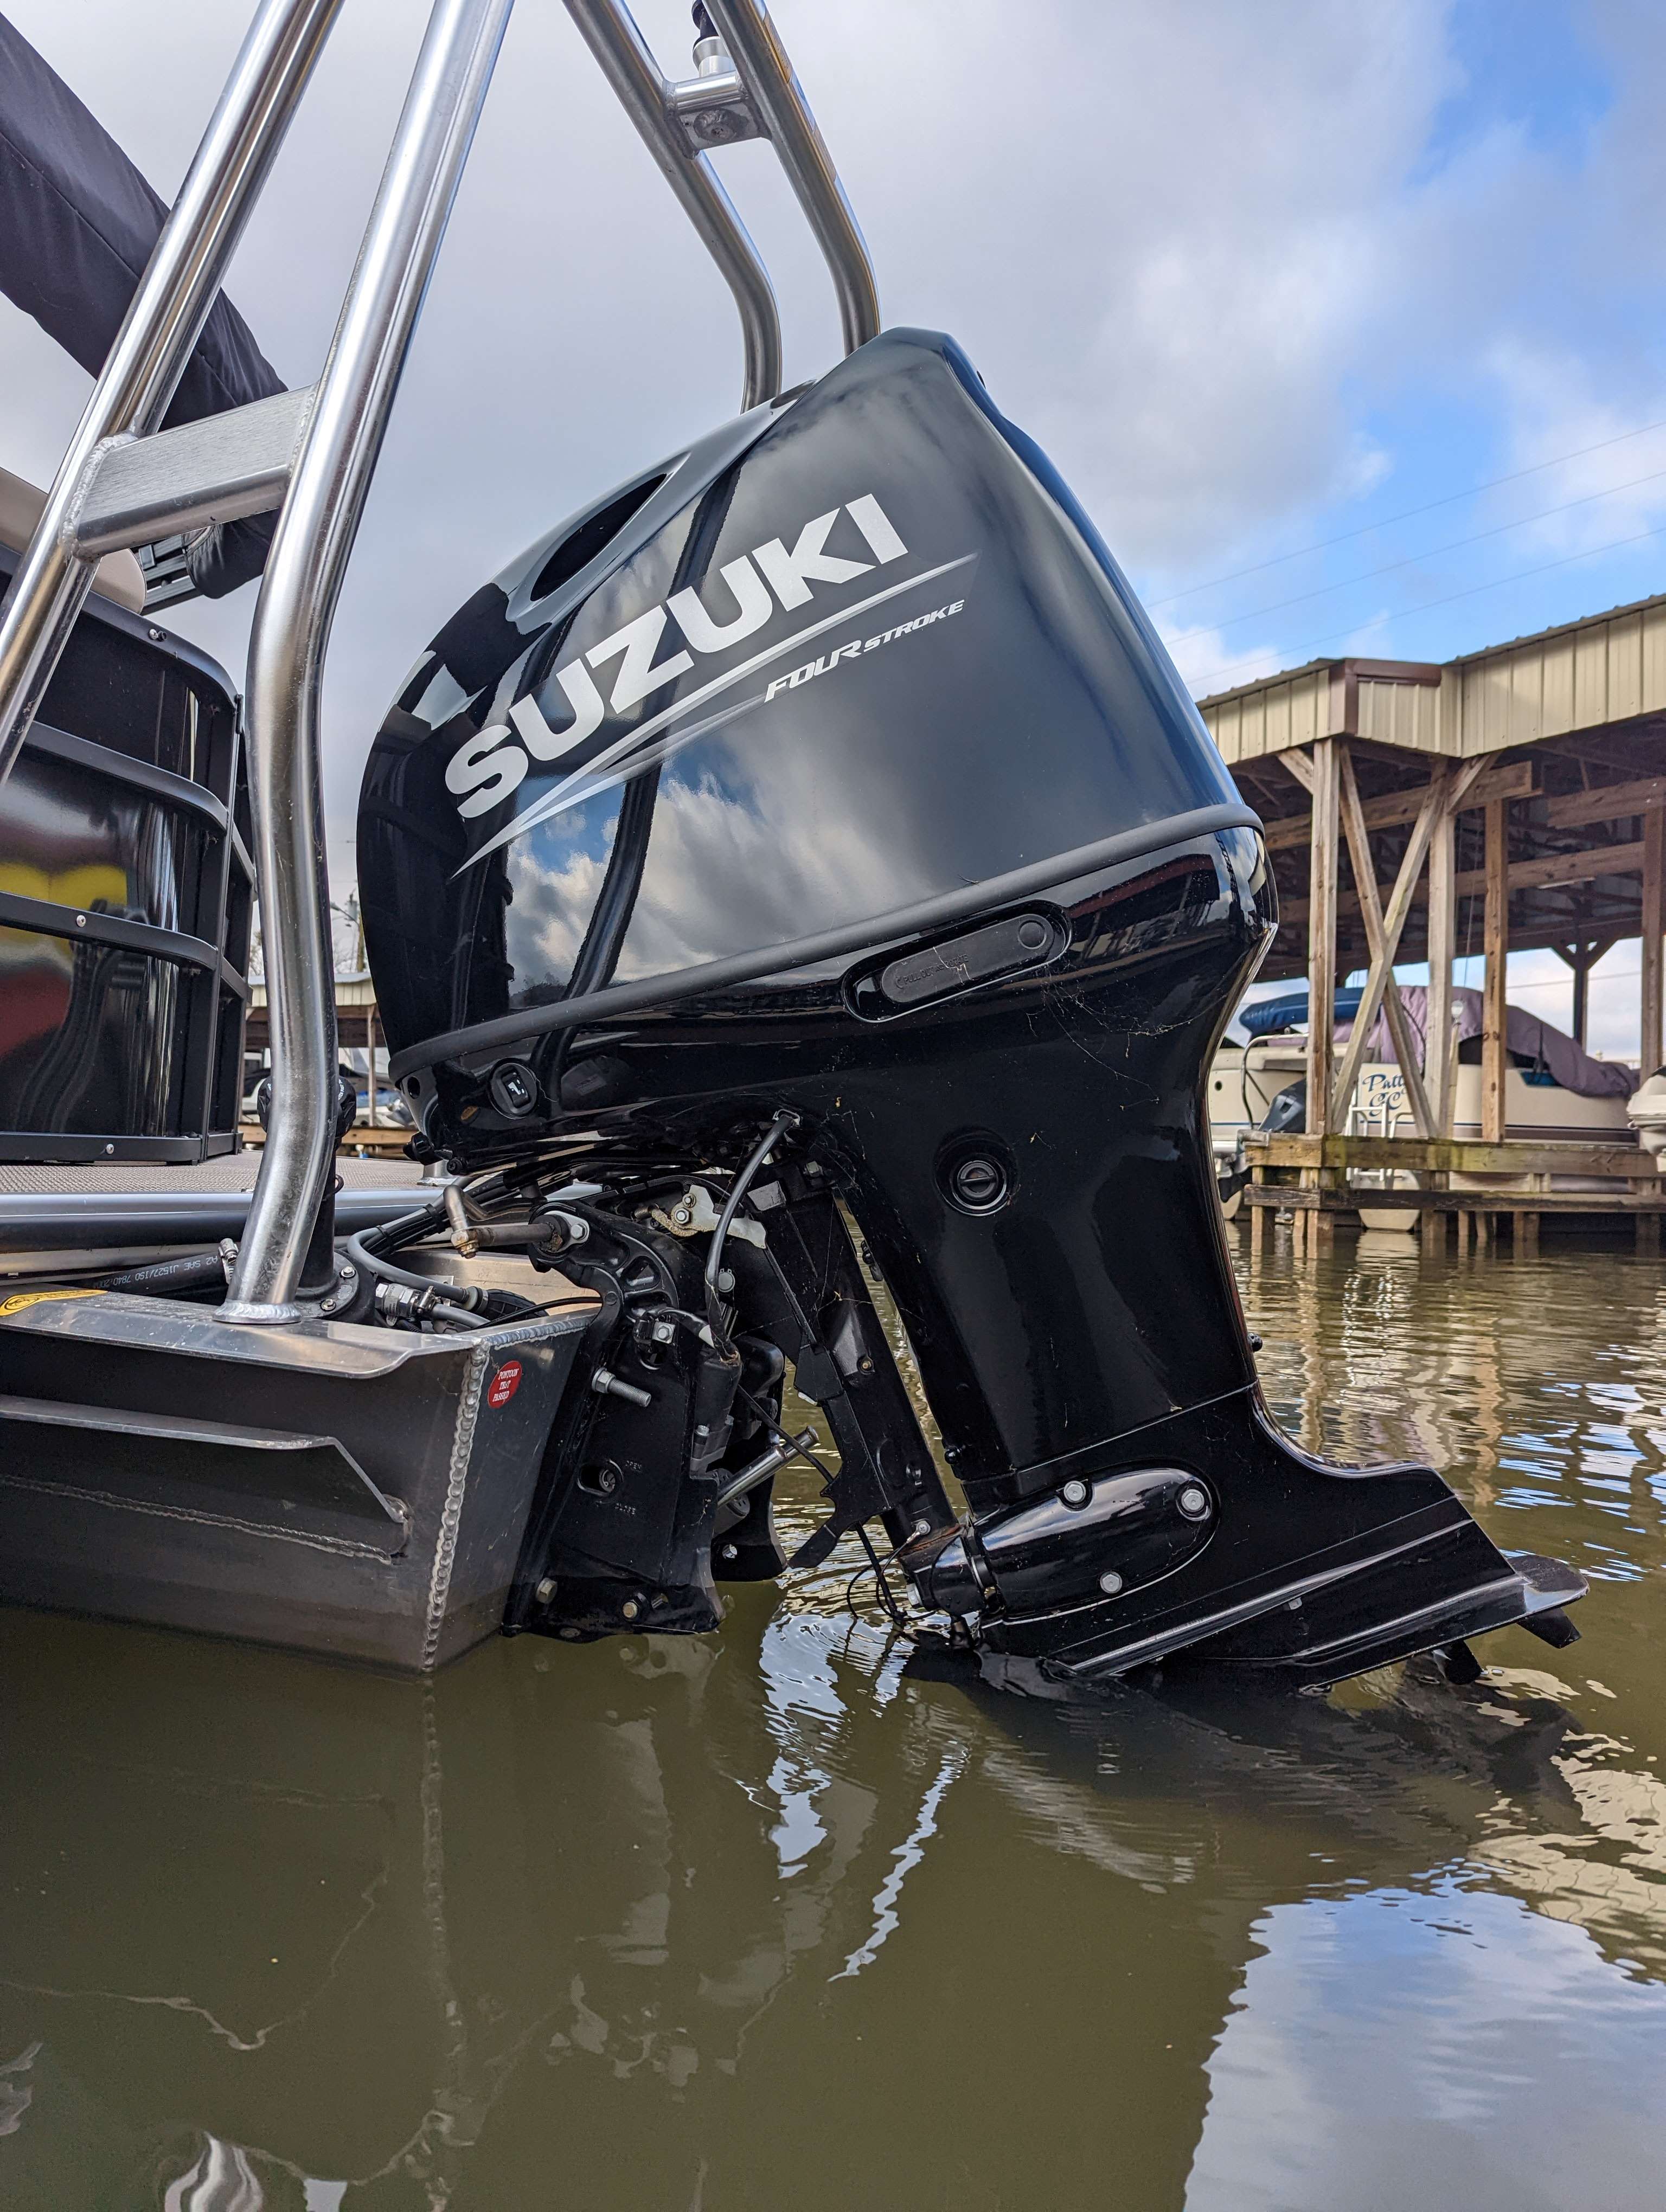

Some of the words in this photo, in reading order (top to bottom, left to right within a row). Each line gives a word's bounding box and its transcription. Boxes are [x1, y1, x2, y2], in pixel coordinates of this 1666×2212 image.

[445, 493, 908, 819] SUZUKI
[764, 639, 862, 703] FOUR
[863, 599, 965, 653] STROKE
[902, 972, 921, 985] PULL
[183, 1259, 201, 1271] SAE
[498, 1368, 520, 1380] PONTOON
[499, 1380, 511, 1391] TEST
[492, 1391, 510, 1403] PASSED
